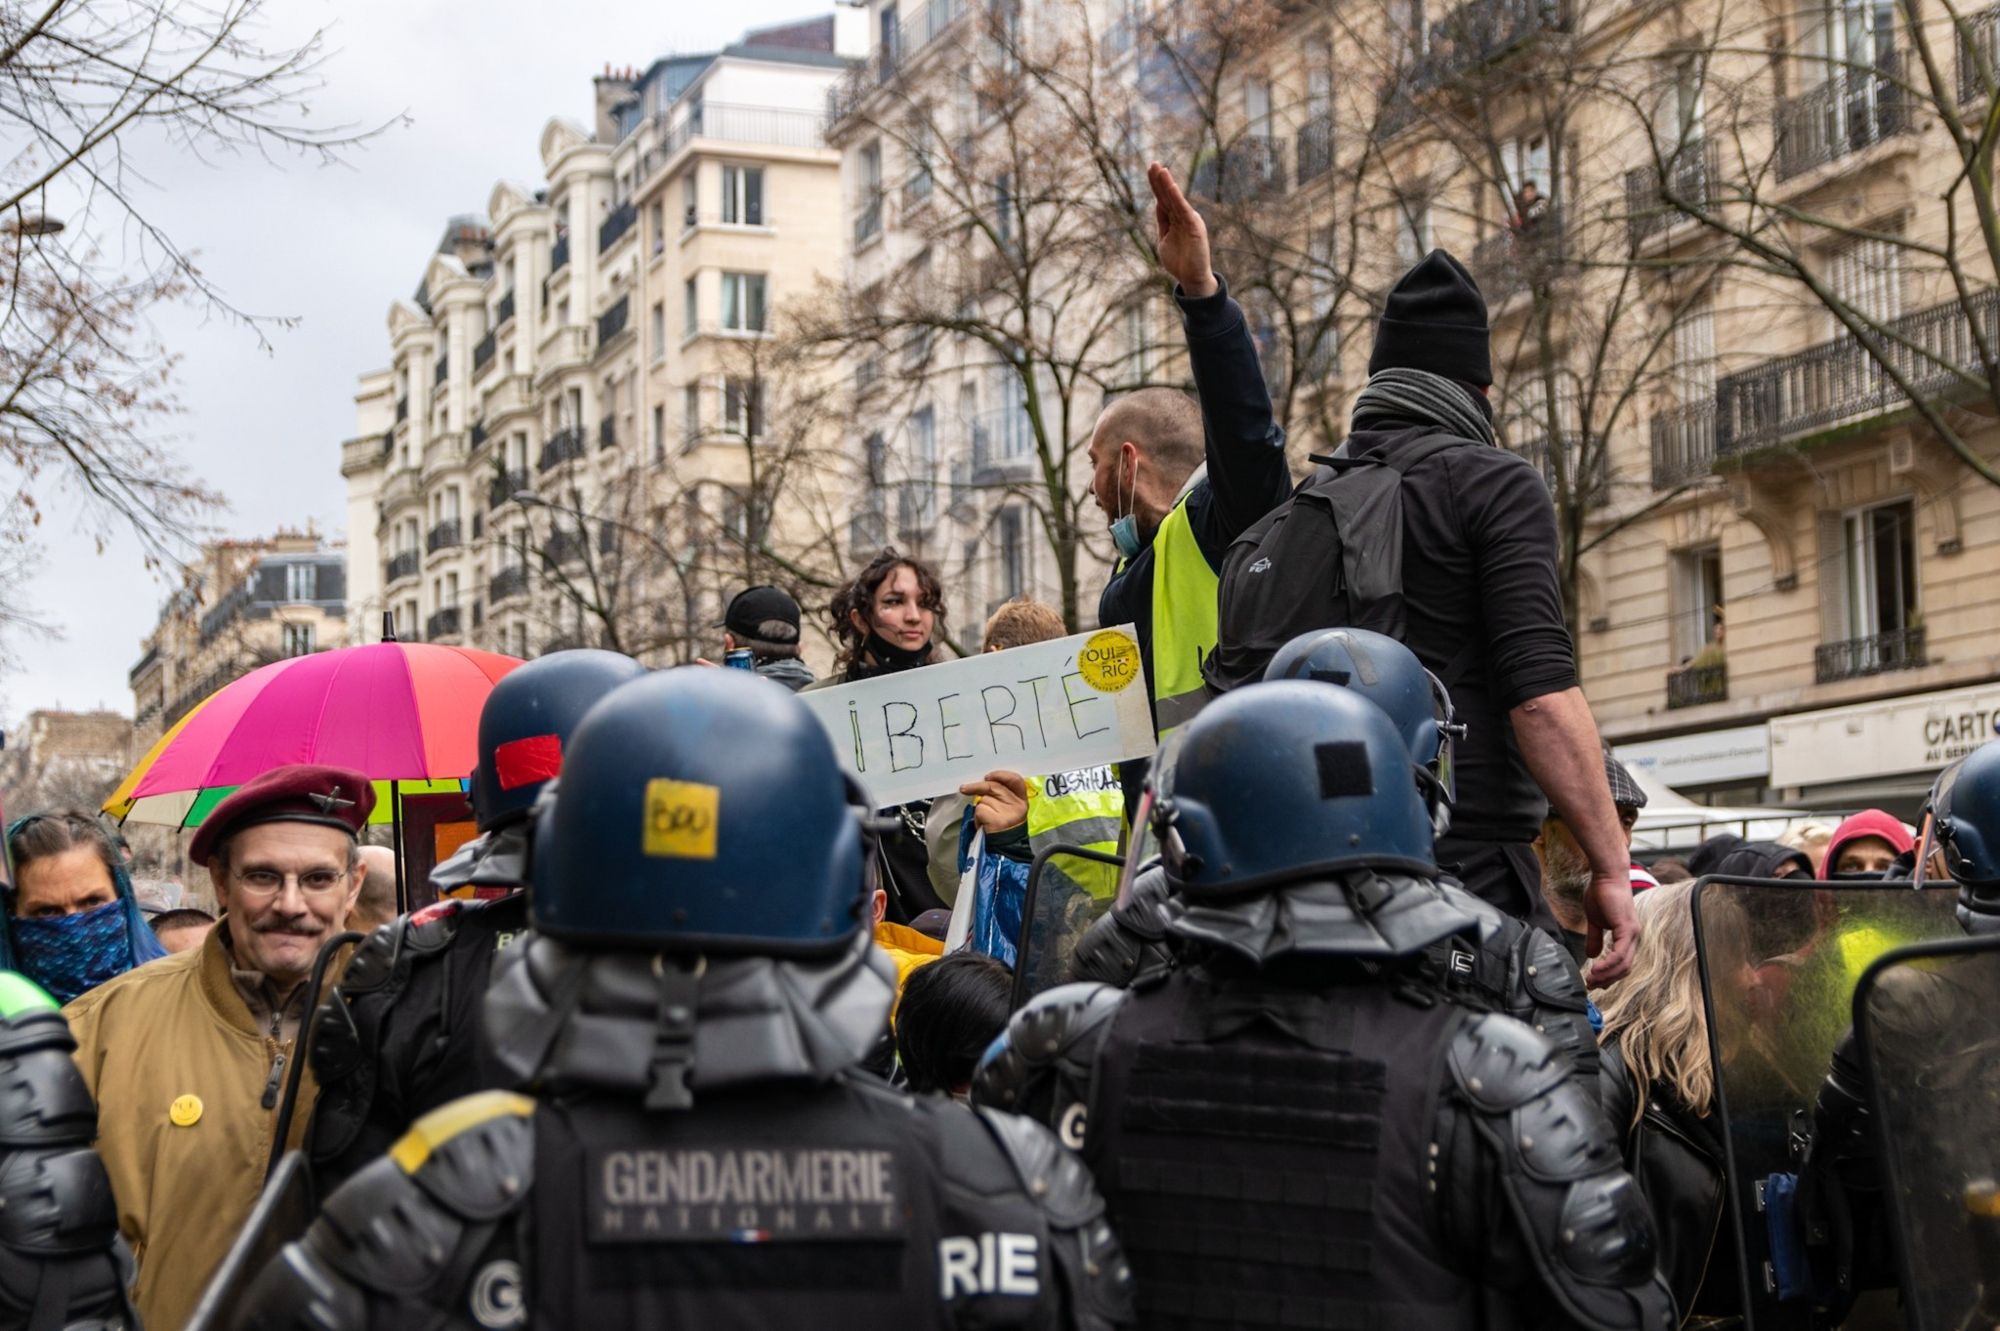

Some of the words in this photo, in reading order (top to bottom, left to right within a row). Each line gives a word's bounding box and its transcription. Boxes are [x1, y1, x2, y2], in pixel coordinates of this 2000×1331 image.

[1086, 647, 1116, 662] OUI
[1102, 663, 1129, 678] RIC
[848, 655, 1111, 774] iBERTÉ
[604, 1150, 895, 1204] GENDARMERIE
[603, 1206, 893, 1230] NATIONALE
